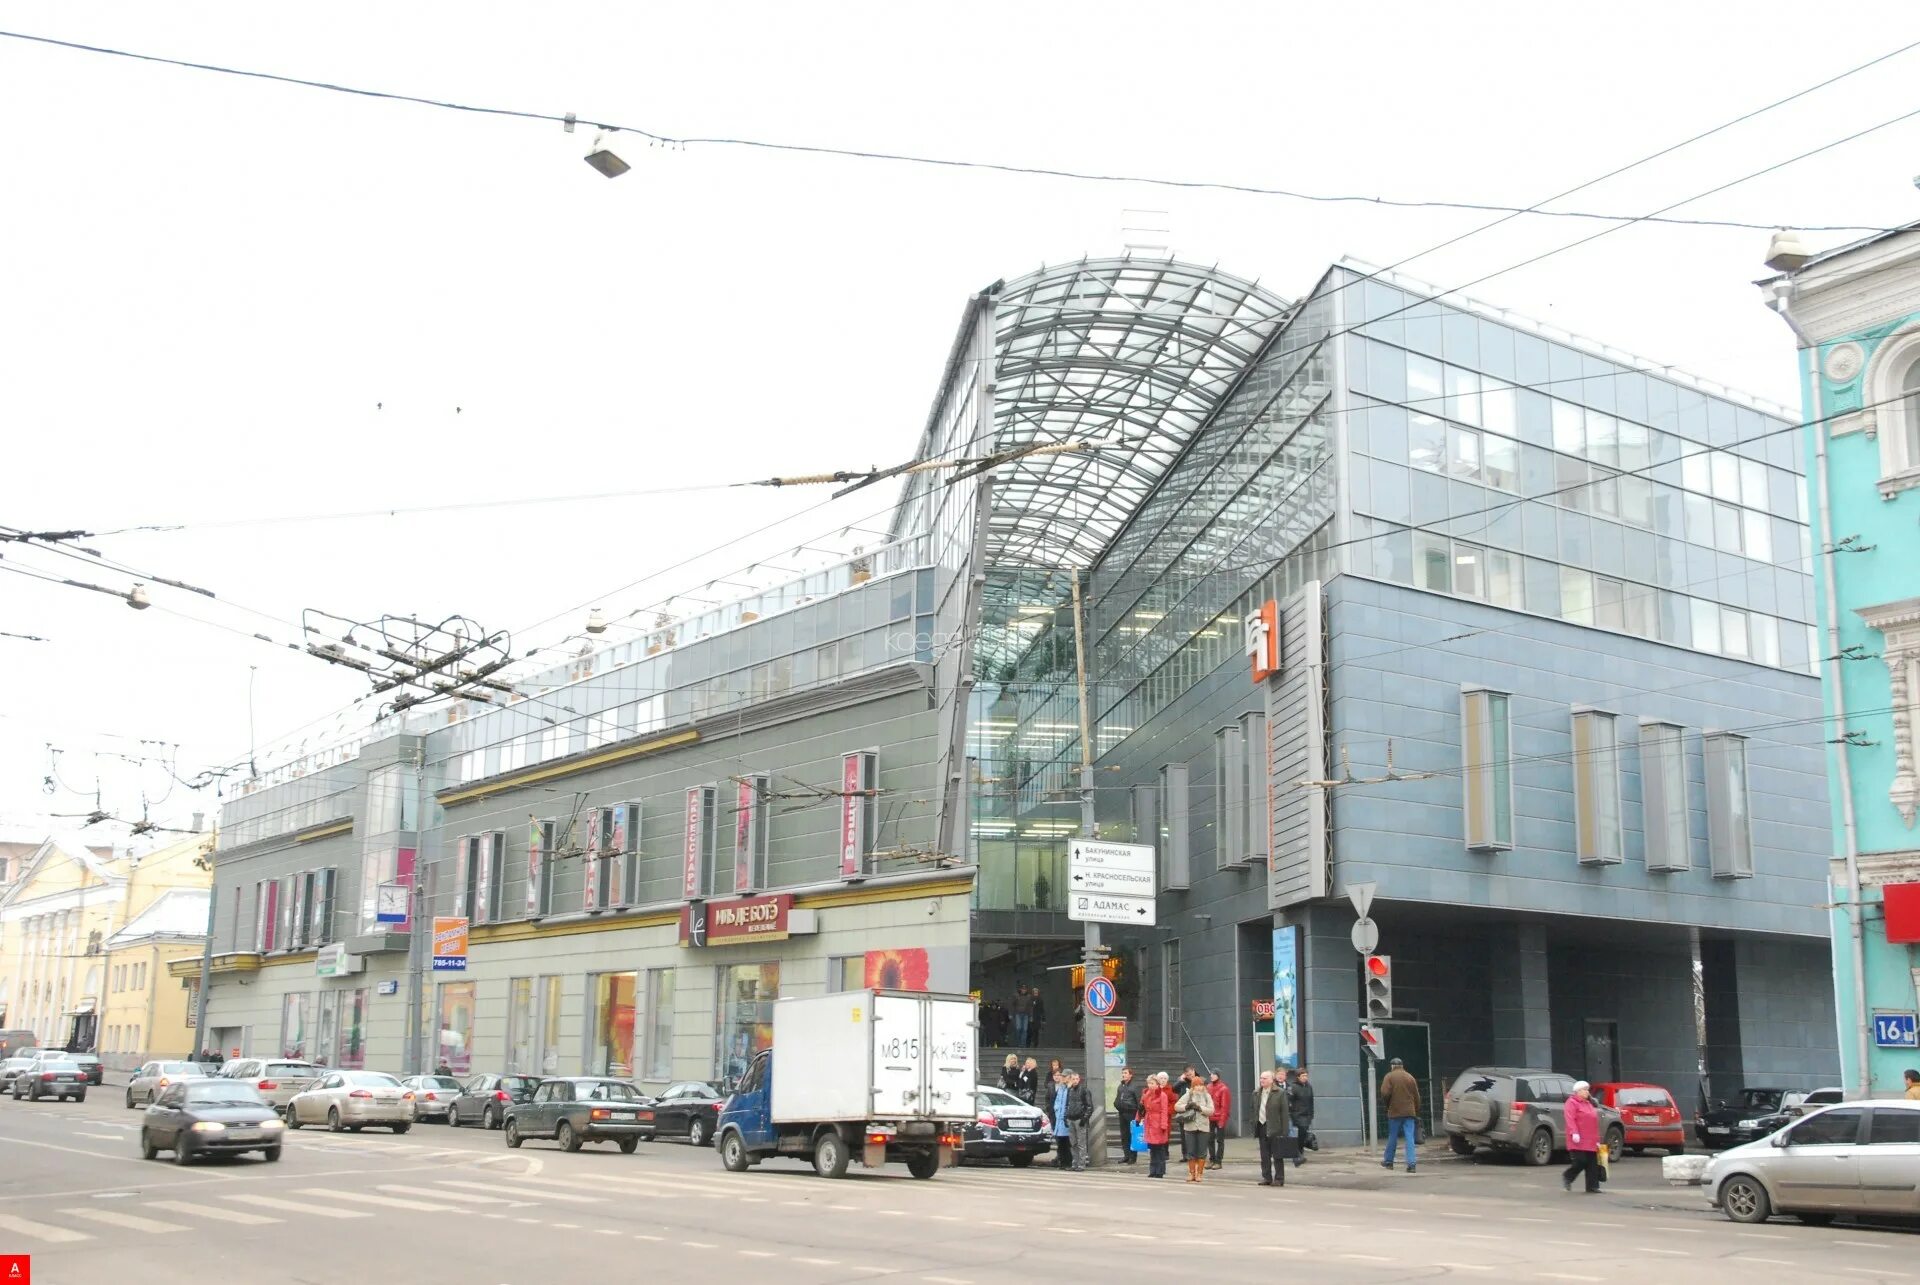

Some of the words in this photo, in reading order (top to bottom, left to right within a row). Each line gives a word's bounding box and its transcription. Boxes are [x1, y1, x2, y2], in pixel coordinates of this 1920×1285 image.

[687, 795, 697, 891] АКСЕССУАРЫ
[1085, 847, 1131, 857] БАКУНИНСКАЯ
[1093, 873, 1151, 883] КРАСНОСЕЛЬСКАЯ
[1093, 901, 1130, 911] АДАМАС
[1878, 1020, 1900, 1040] 16
